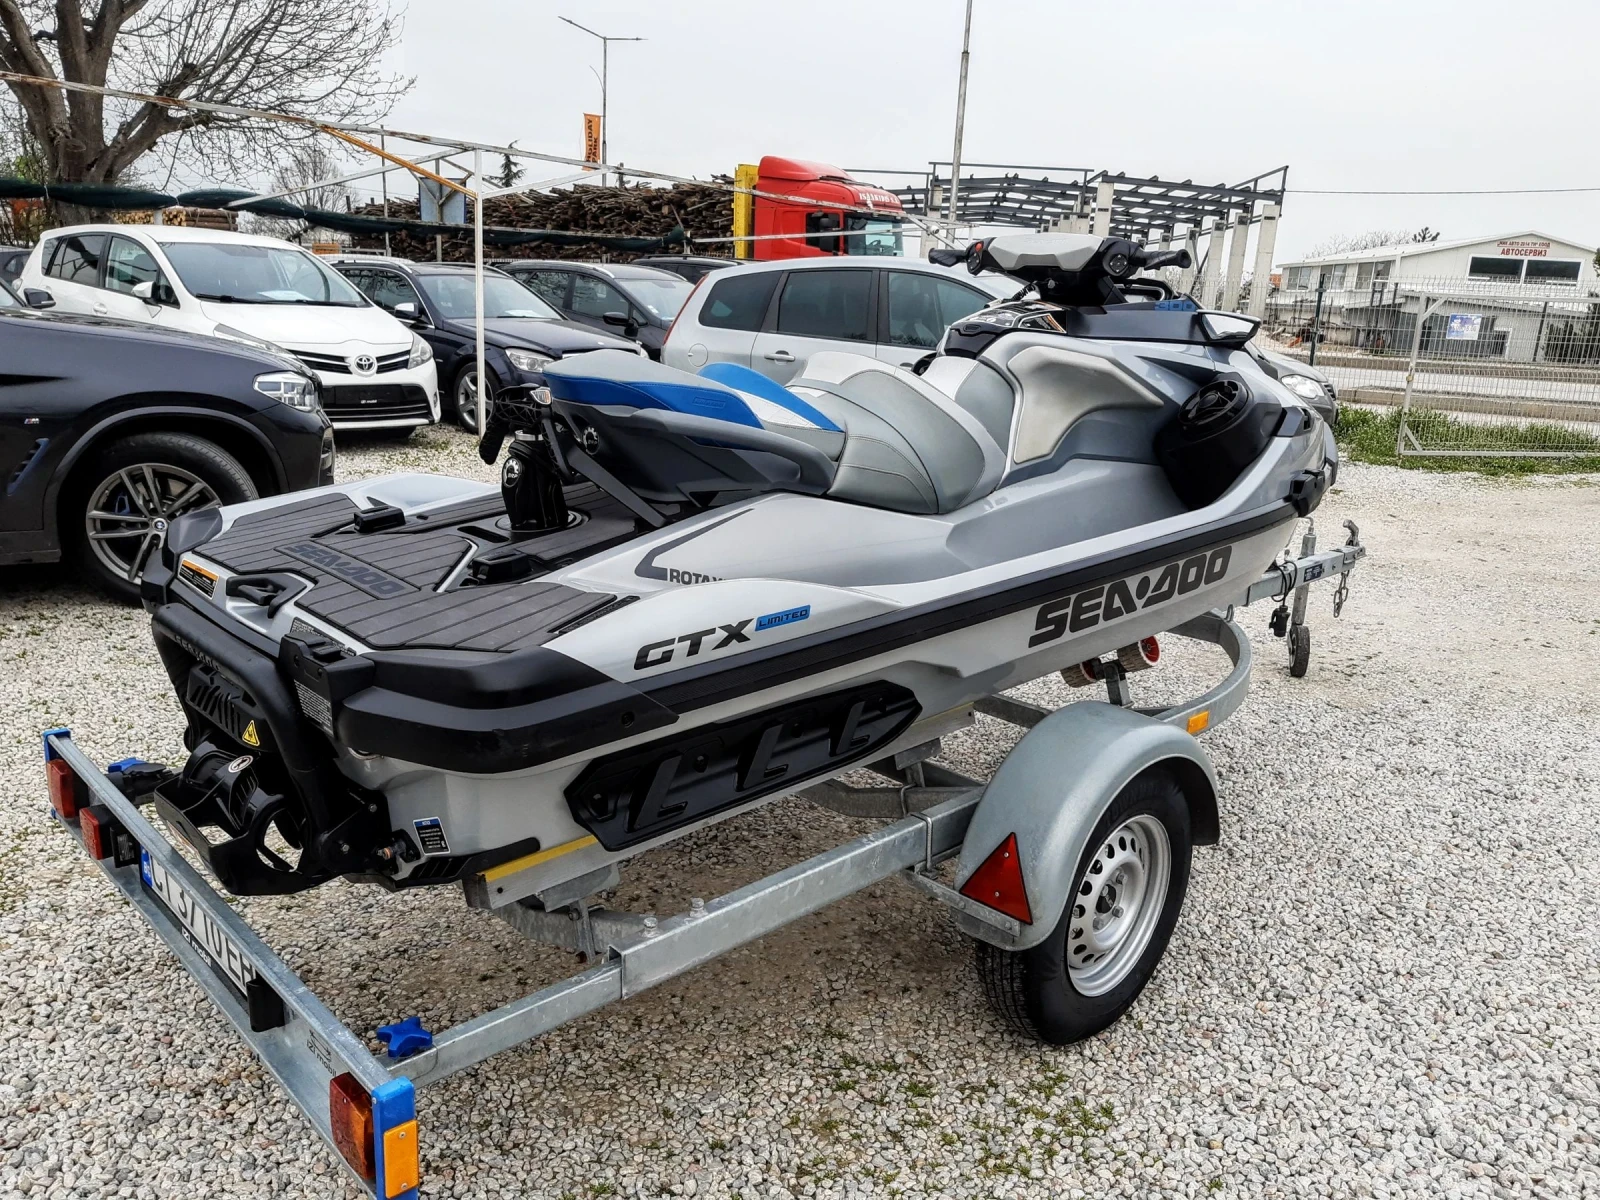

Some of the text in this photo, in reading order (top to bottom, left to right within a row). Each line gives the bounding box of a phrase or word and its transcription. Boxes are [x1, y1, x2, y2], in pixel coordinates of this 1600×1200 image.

[1500, 248, 1548, 257] АВТОСЕРВИЗ
[669, 568, 723, 585] ROTA
[634, 608, 809, 670] GTX LIMITED
[316, 1053, 337, 1077] mobil
